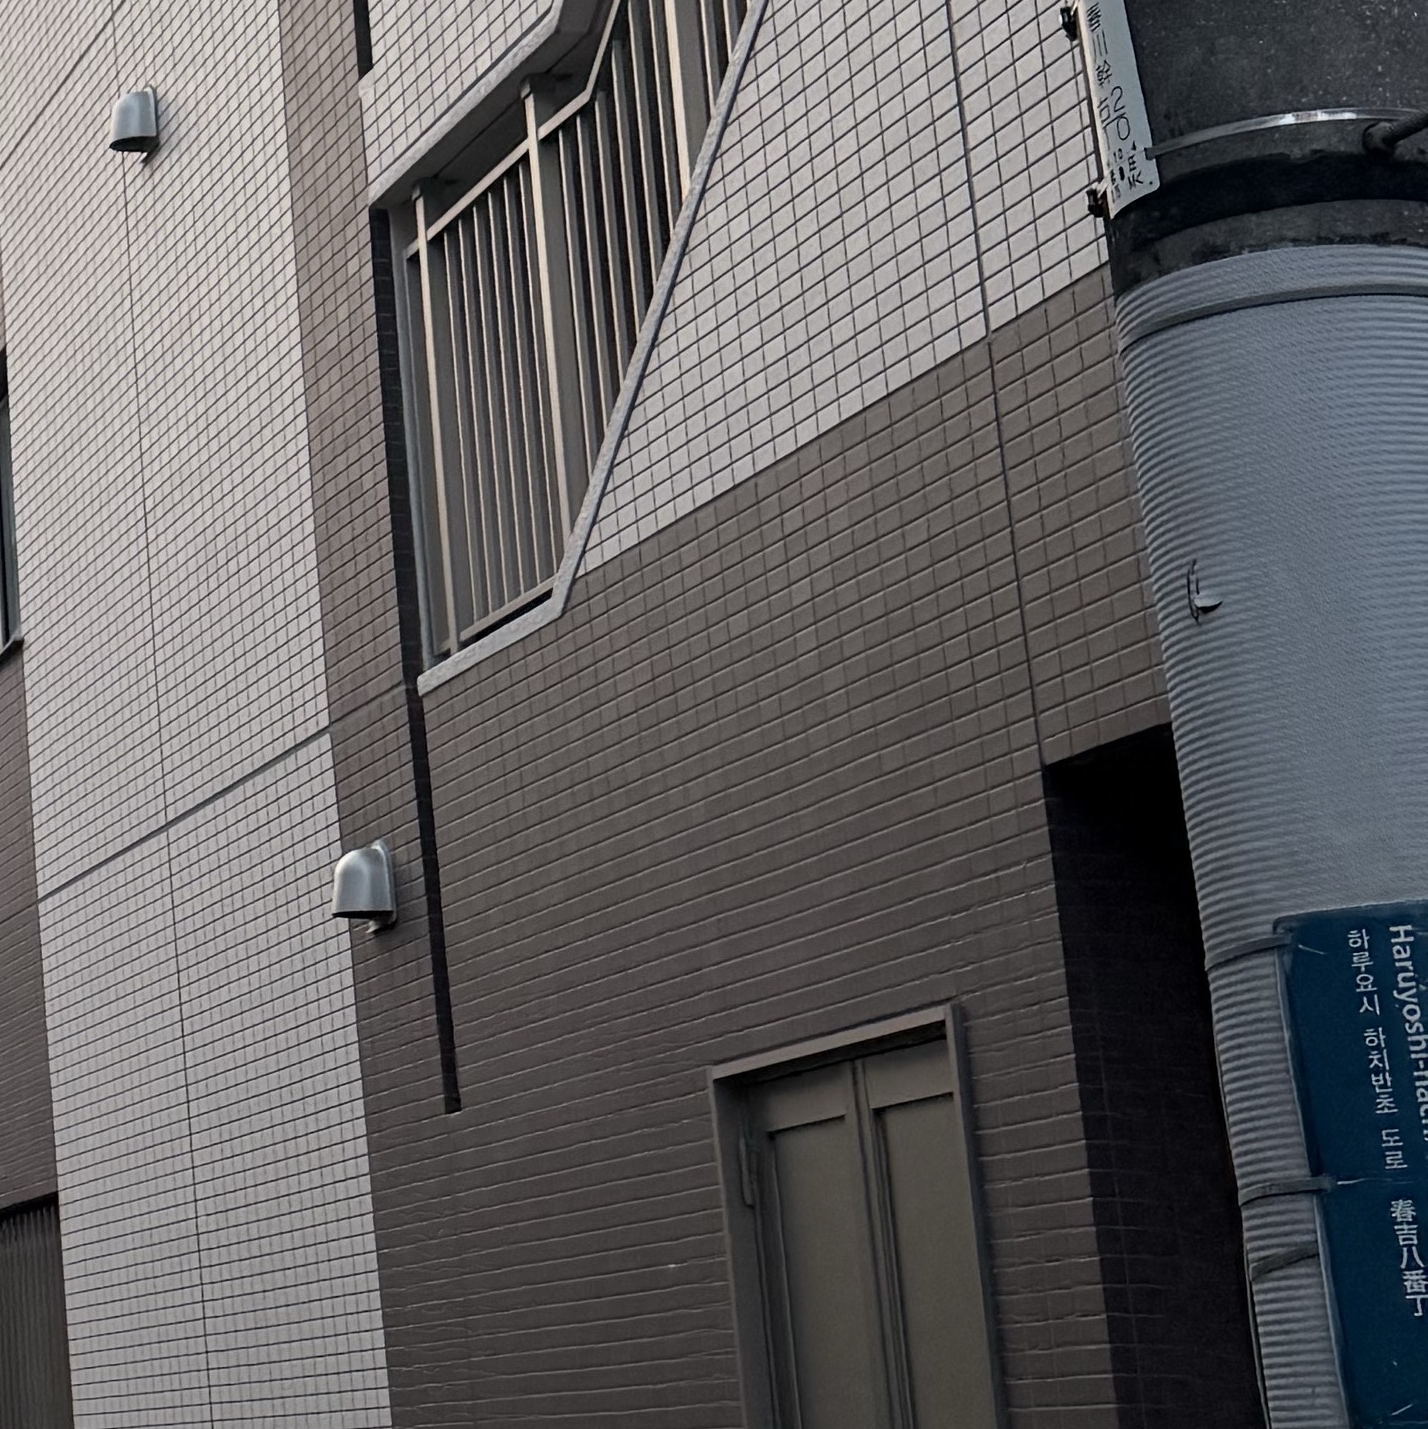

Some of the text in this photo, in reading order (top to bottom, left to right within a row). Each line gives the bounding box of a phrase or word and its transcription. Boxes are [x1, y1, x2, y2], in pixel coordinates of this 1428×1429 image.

[1347, 928, 1381, 1016] 하루요시
[1381, 1128, 1408, 1170] 도로
[1391, 1199, 1428, 1317] 春吉八番丁
